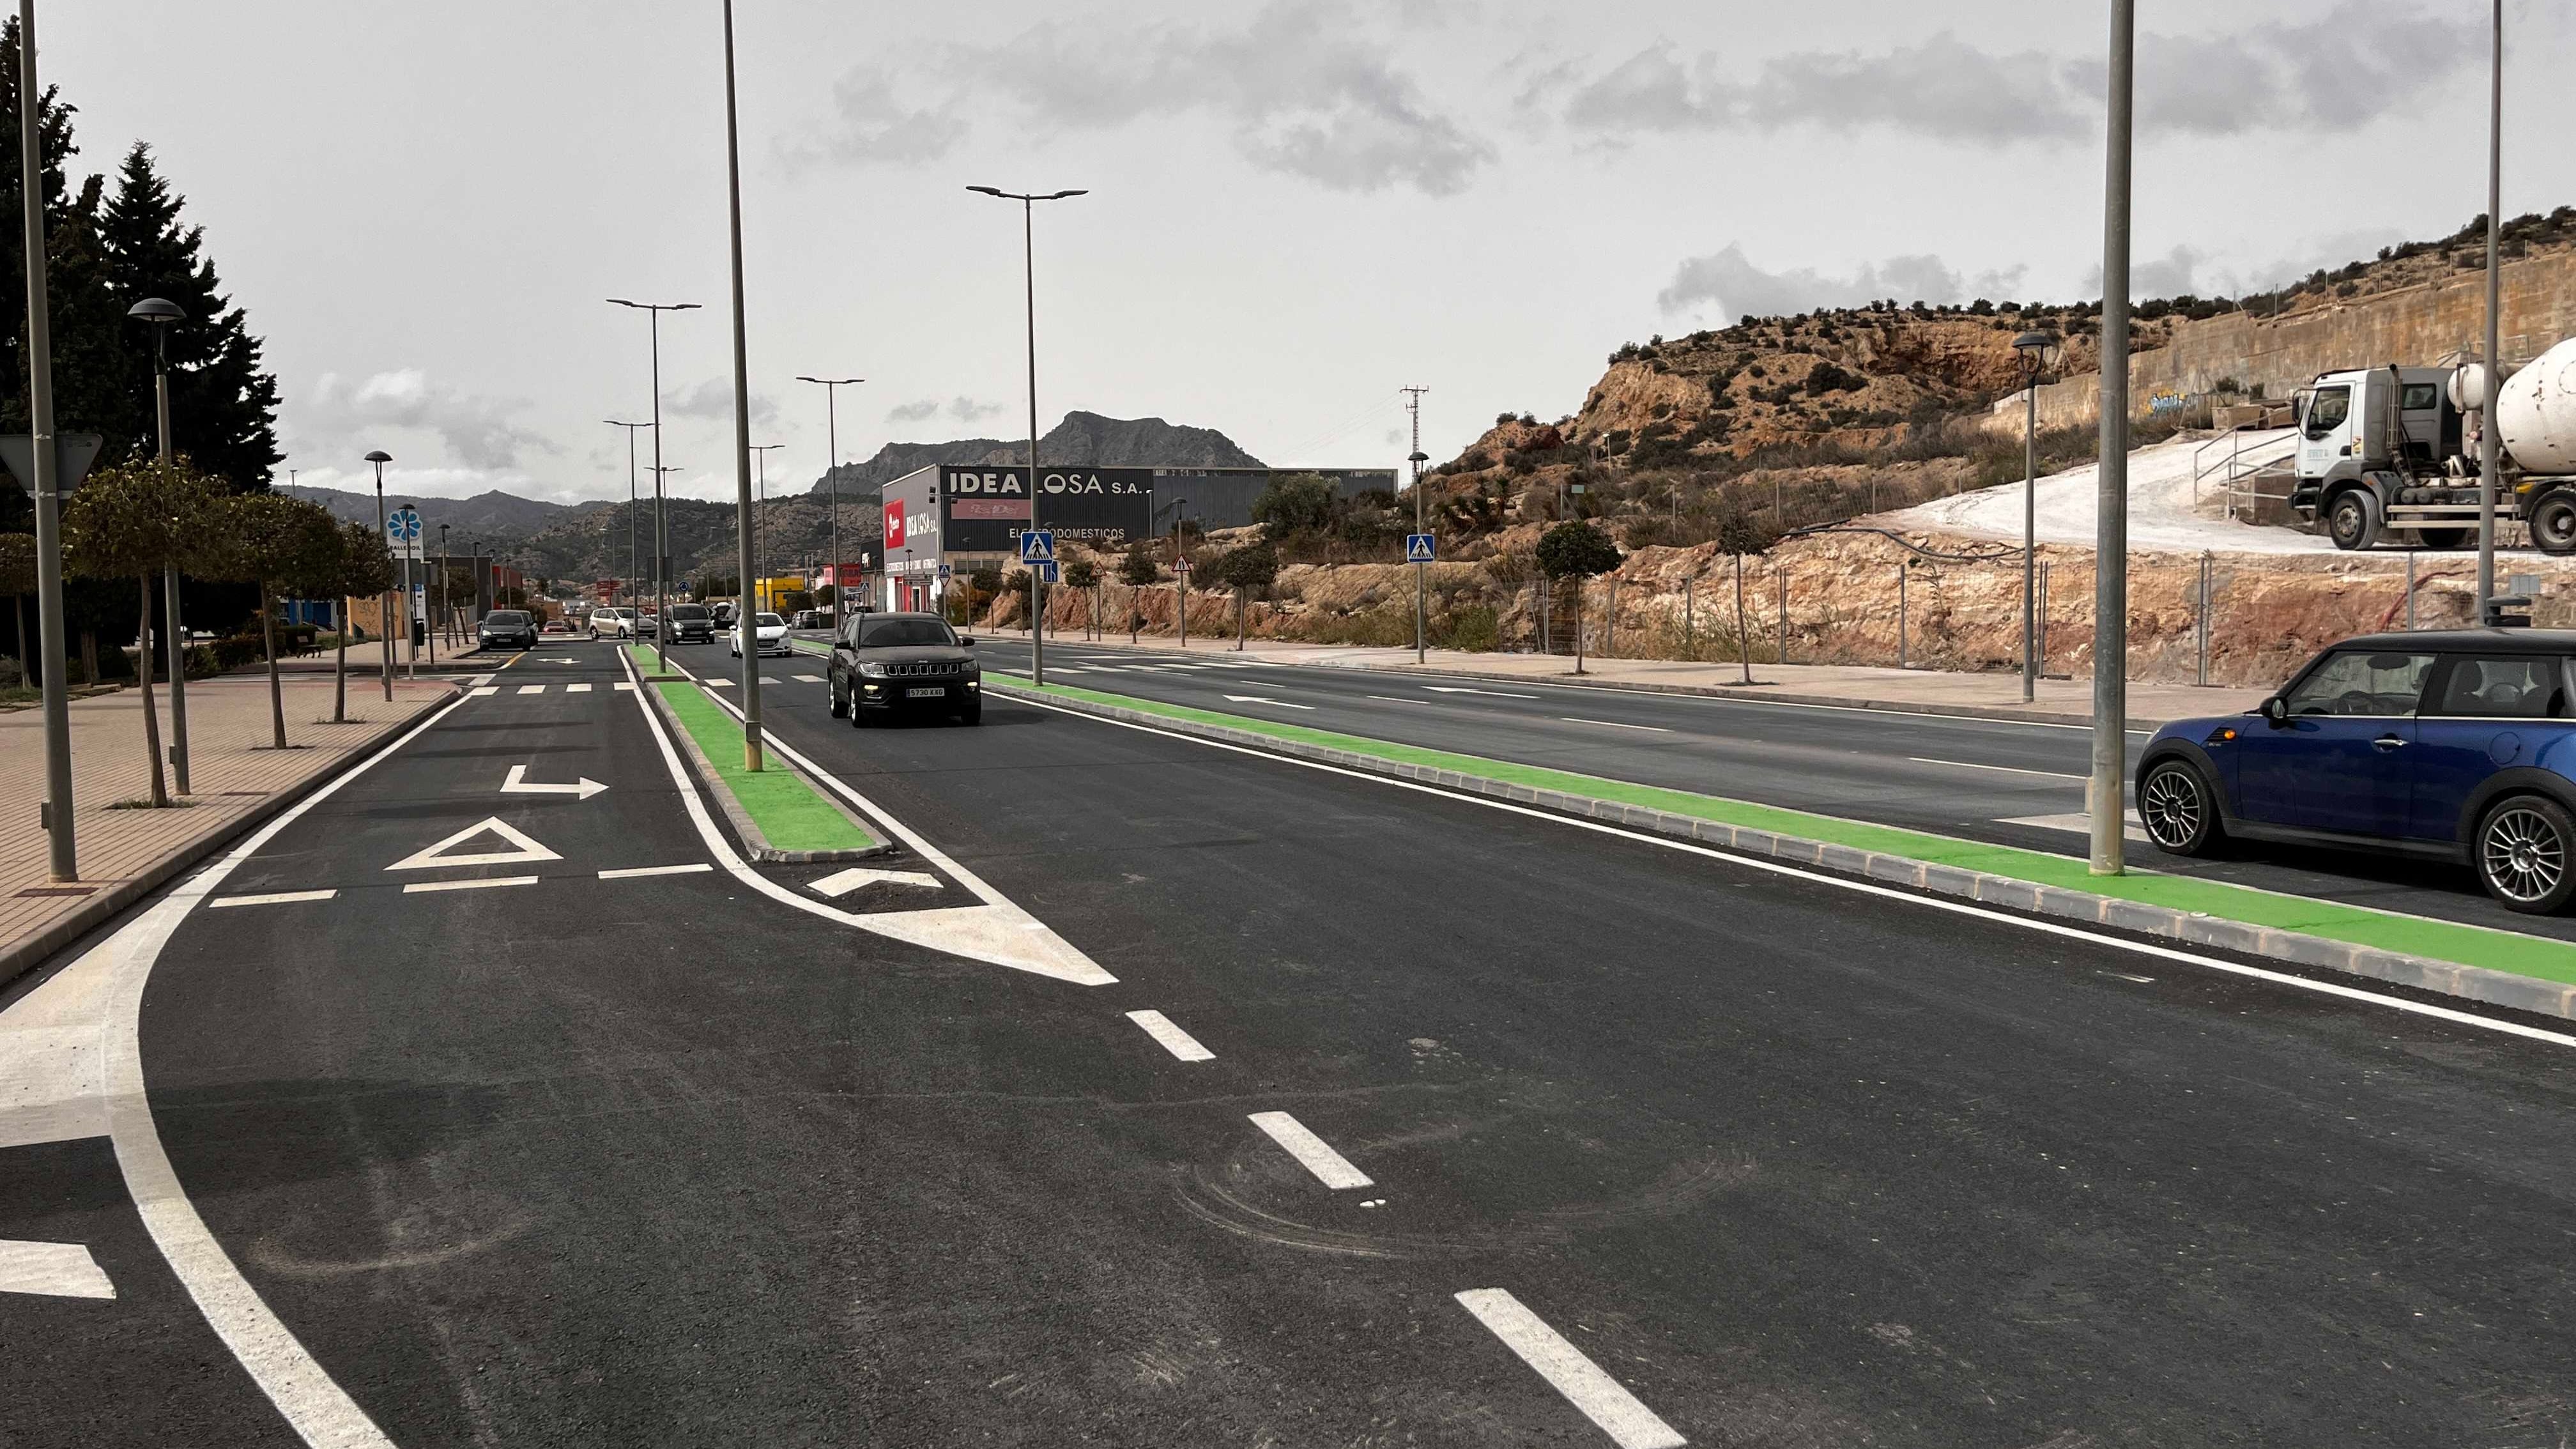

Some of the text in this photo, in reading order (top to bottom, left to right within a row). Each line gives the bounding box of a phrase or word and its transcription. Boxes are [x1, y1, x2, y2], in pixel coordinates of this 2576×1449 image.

[950, 473, 1142, 494] IDEA OSA S.A.
